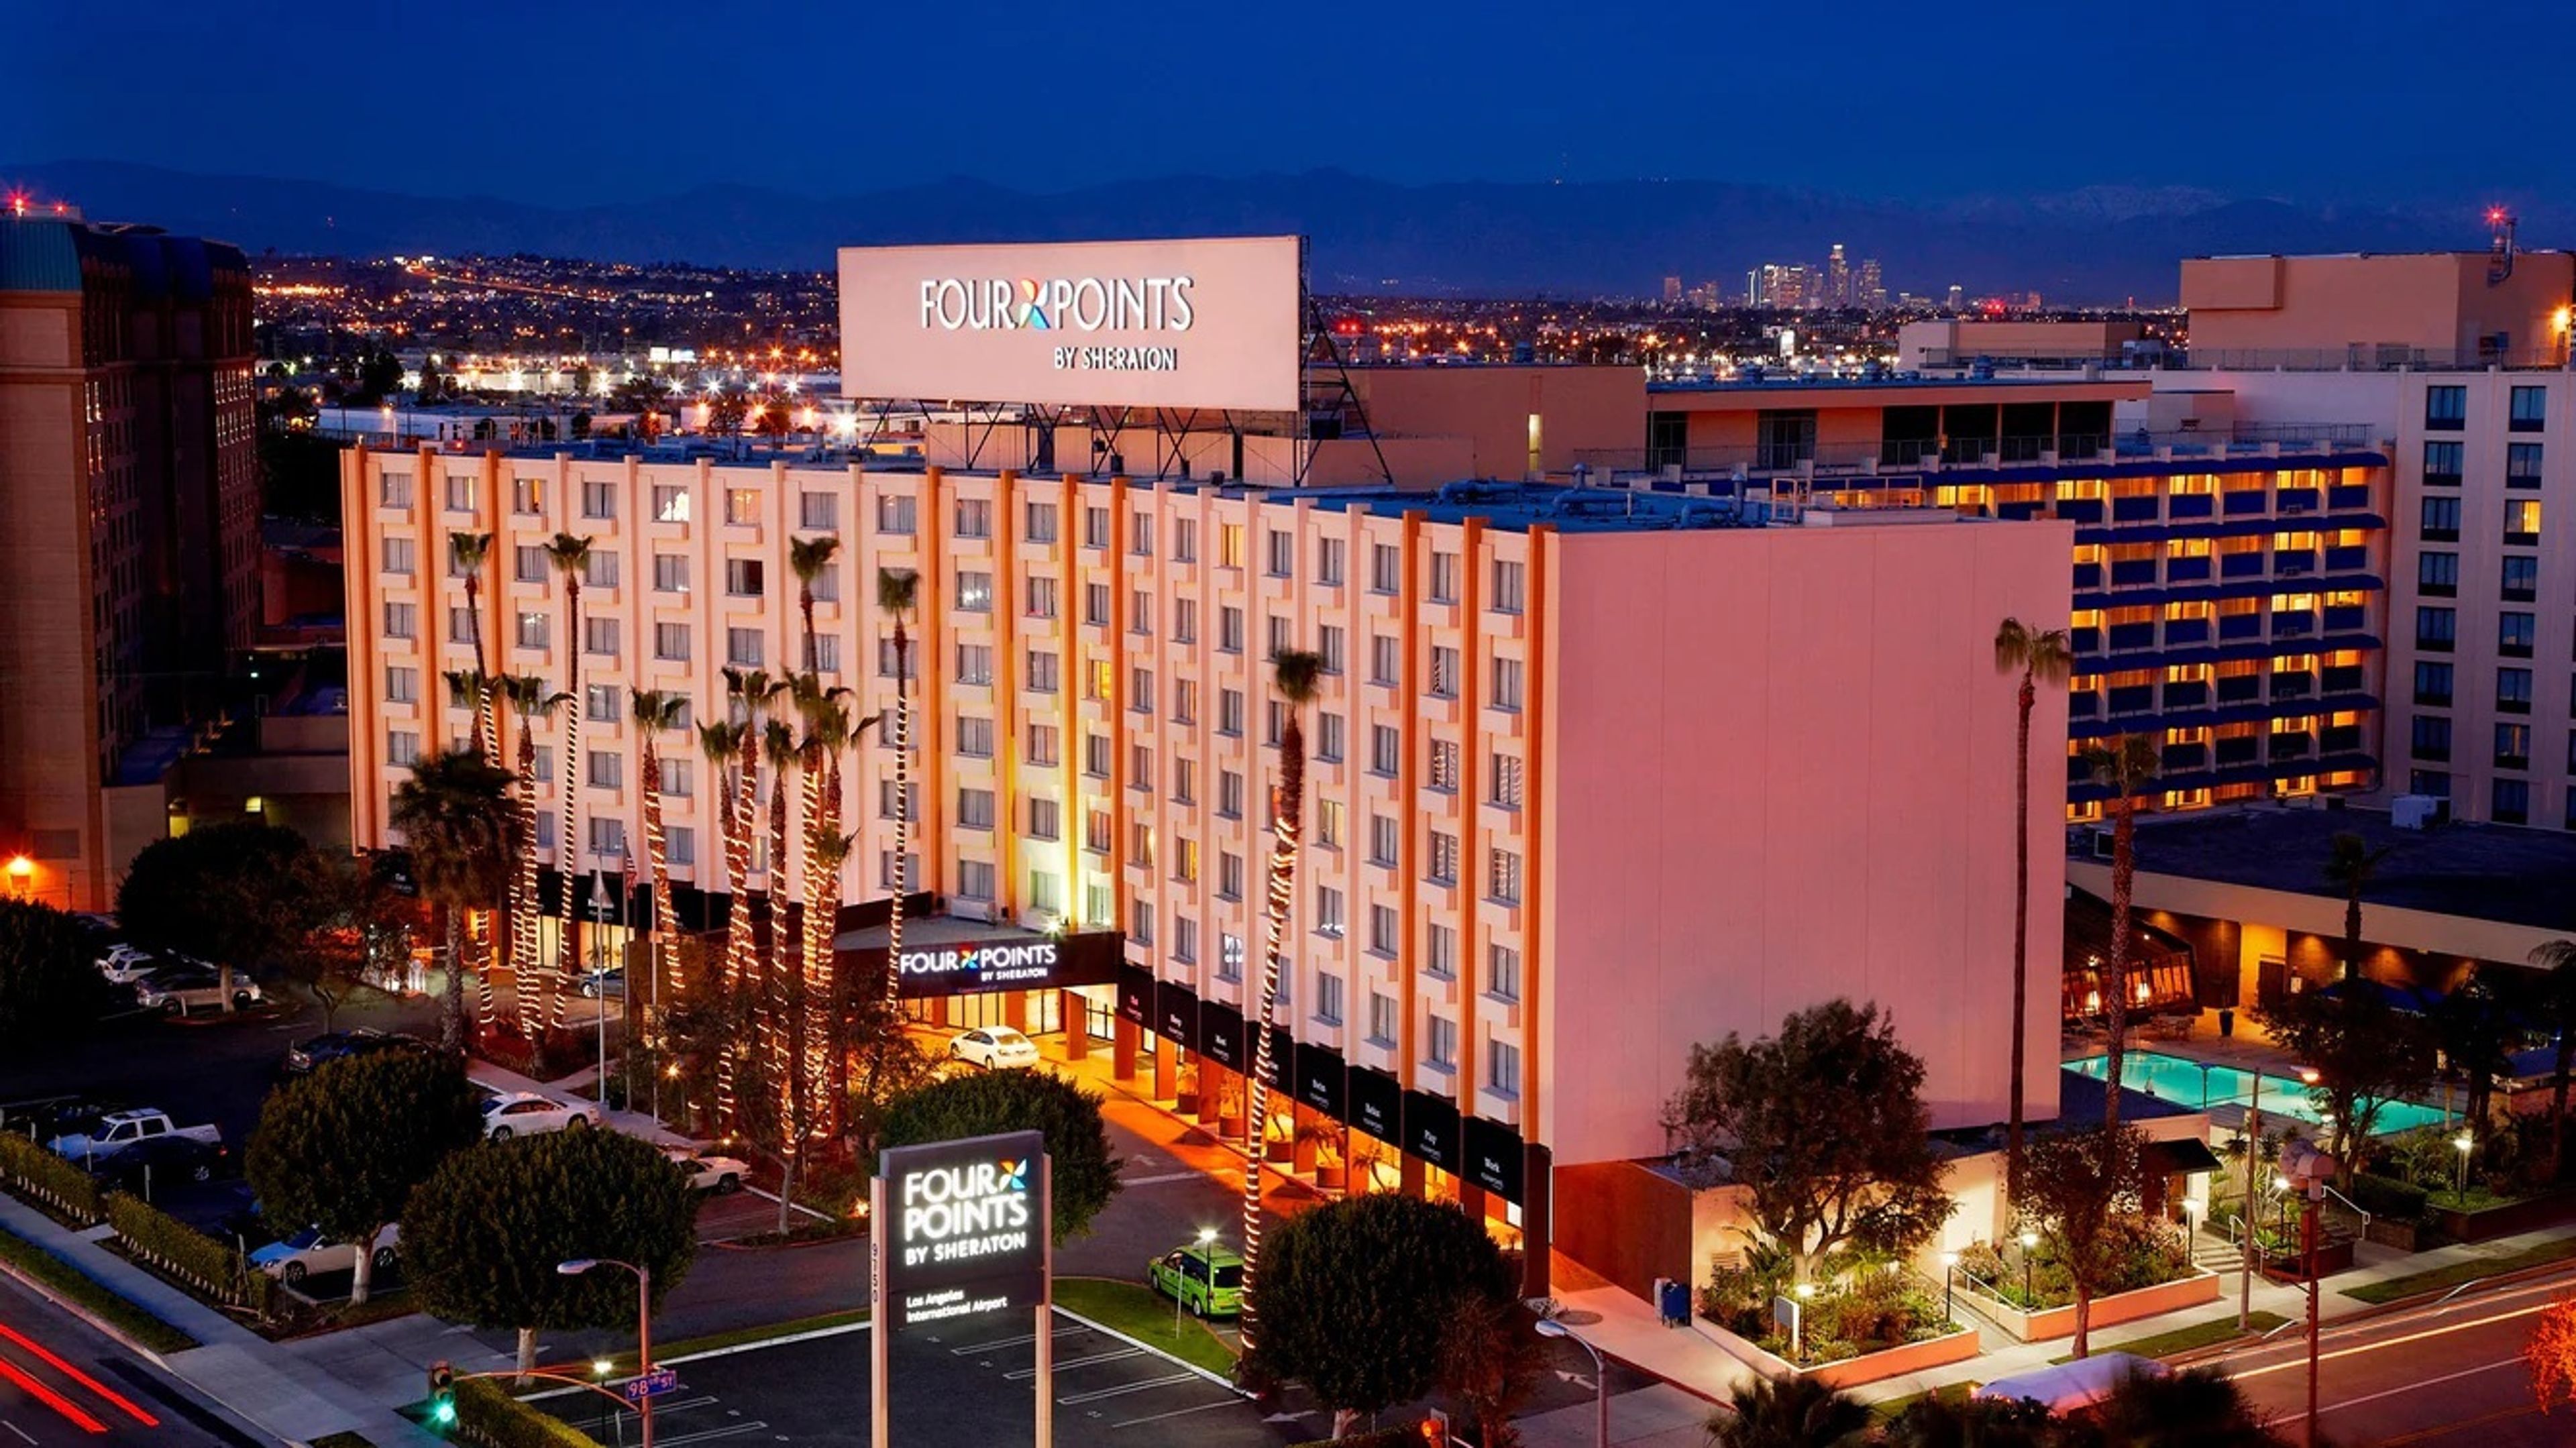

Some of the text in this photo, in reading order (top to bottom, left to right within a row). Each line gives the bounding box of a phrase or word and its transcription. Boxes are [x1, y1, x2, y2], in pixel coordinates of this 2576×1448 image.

[921, 276, 1194, 331] FOUR POINTS
[1054, 347, 1178, 370] BY SHERATON
[900, 944, 1056, 974] FOUR POINTS
[981, 968, 1048, 982] BY SHERATON
[905, 1163, 998, 1206] FOUR
[905, 1192, 1028, 1241] POINTS
[906, 1232, 1027, 1266] BY SHERATON
[906, 1289, 964, 1308] Los Angeles
[906, 1296, 1008, 1323] International Airport
